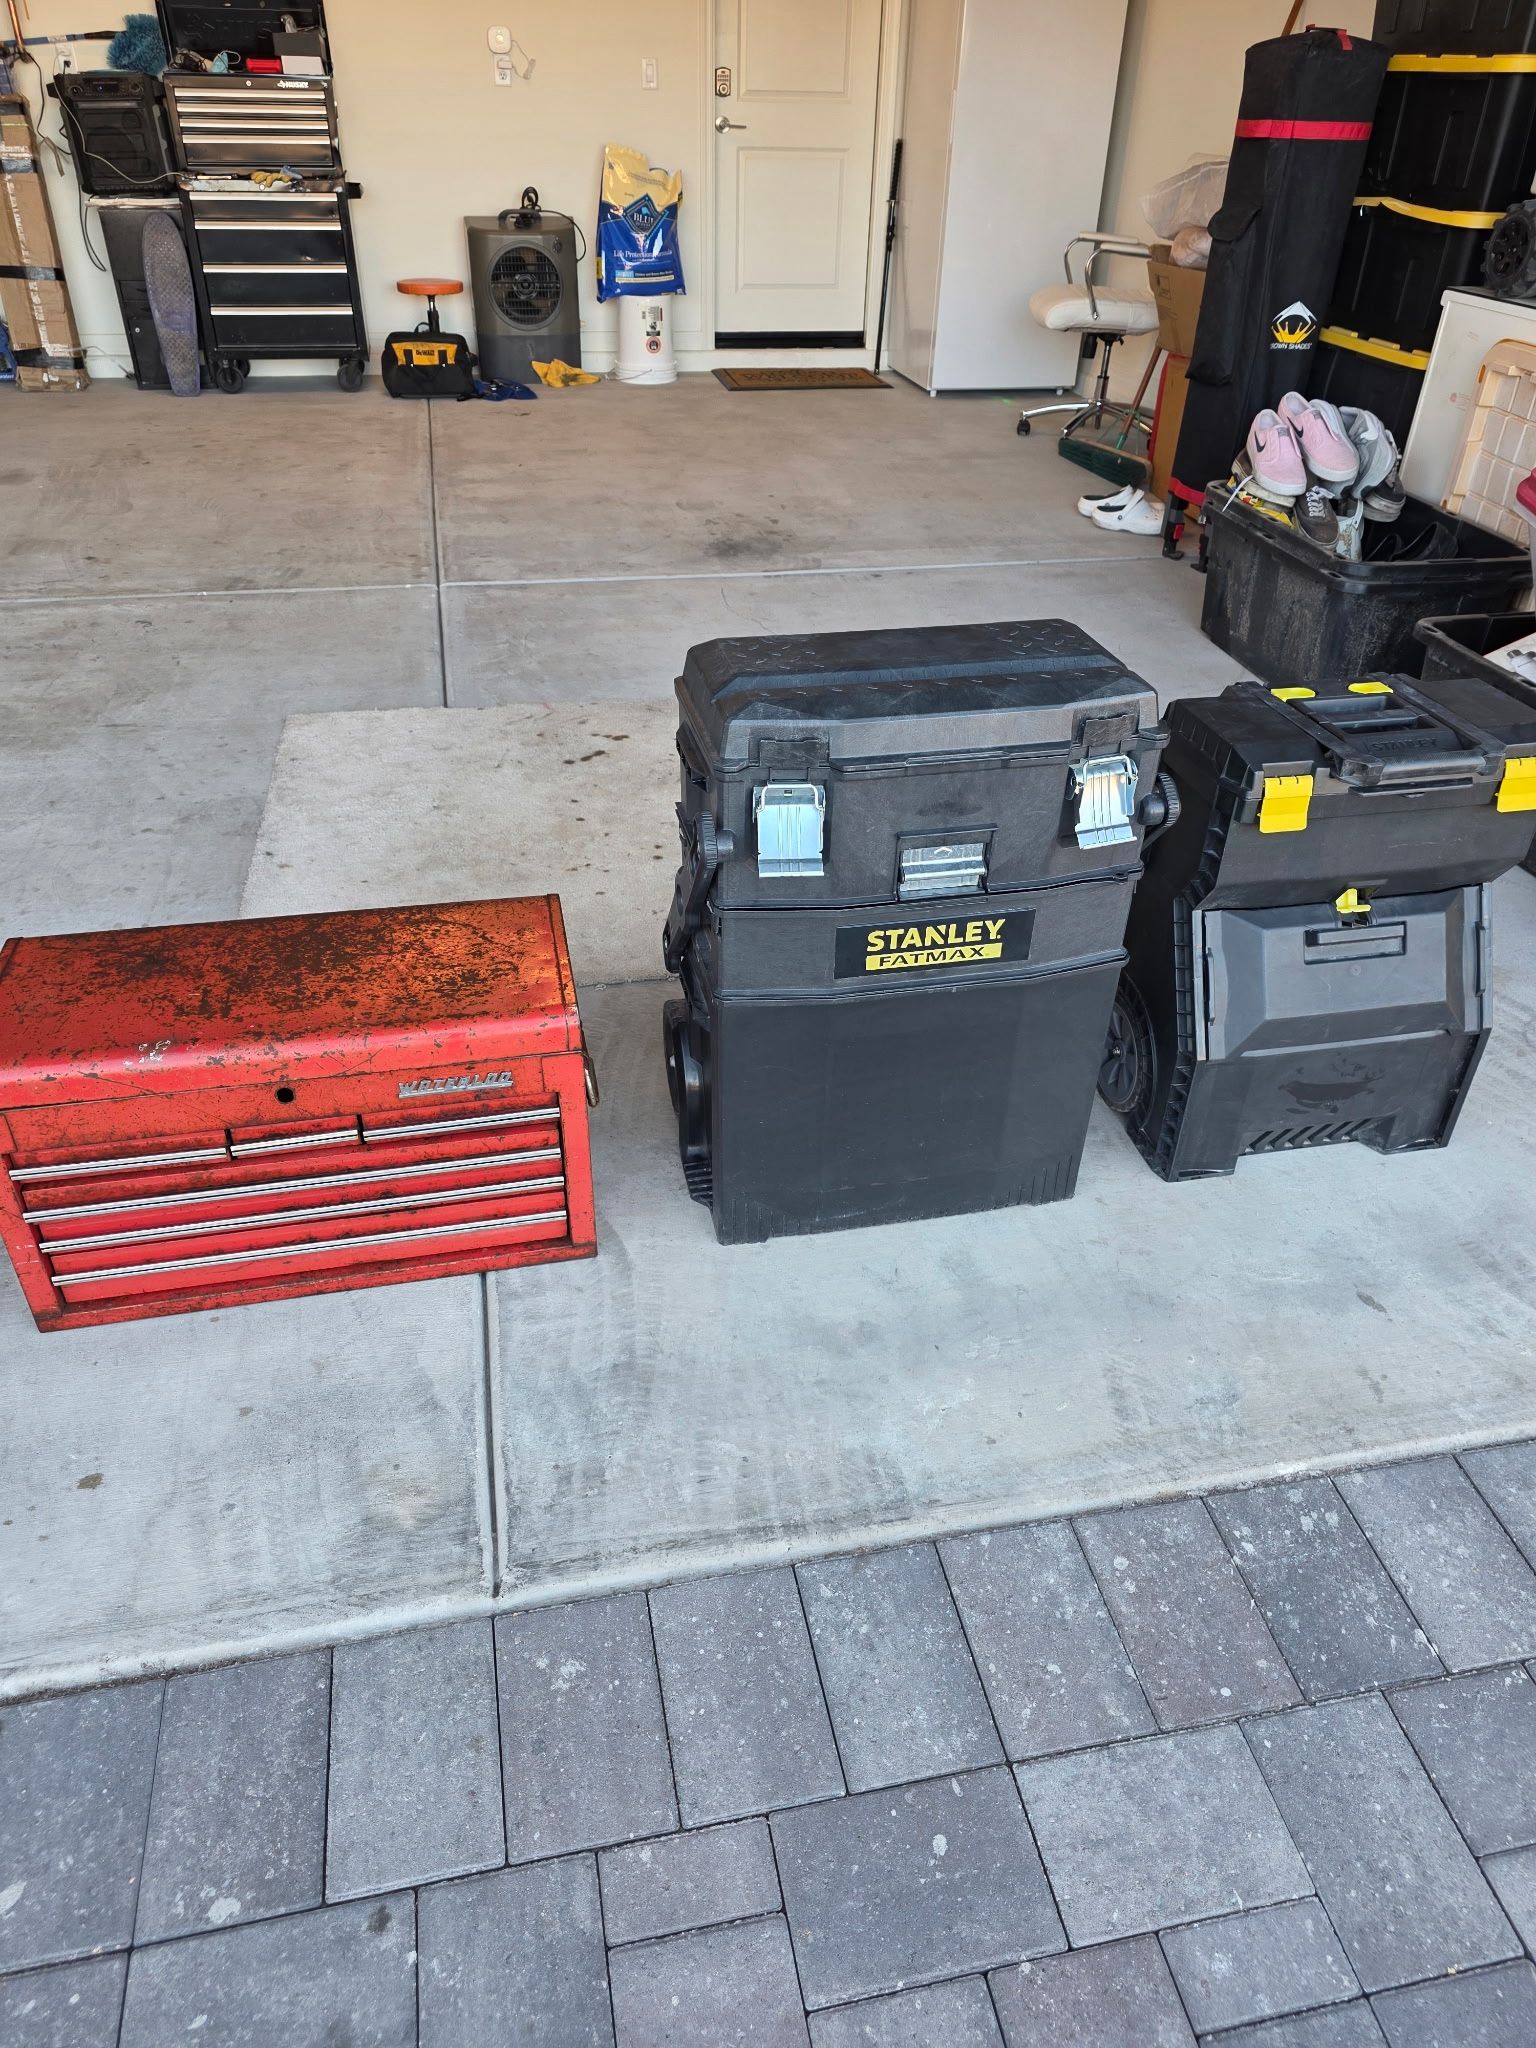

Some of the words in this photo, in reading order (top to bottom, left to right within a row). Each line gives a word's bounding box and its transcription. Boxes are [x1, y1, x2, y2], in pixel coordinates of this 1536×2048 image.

[866, 919, 1005, 951] STANLEY
[879, 947, 984, 967] FATMAX
[399, 1072, 512, 1097] WATERLOO
